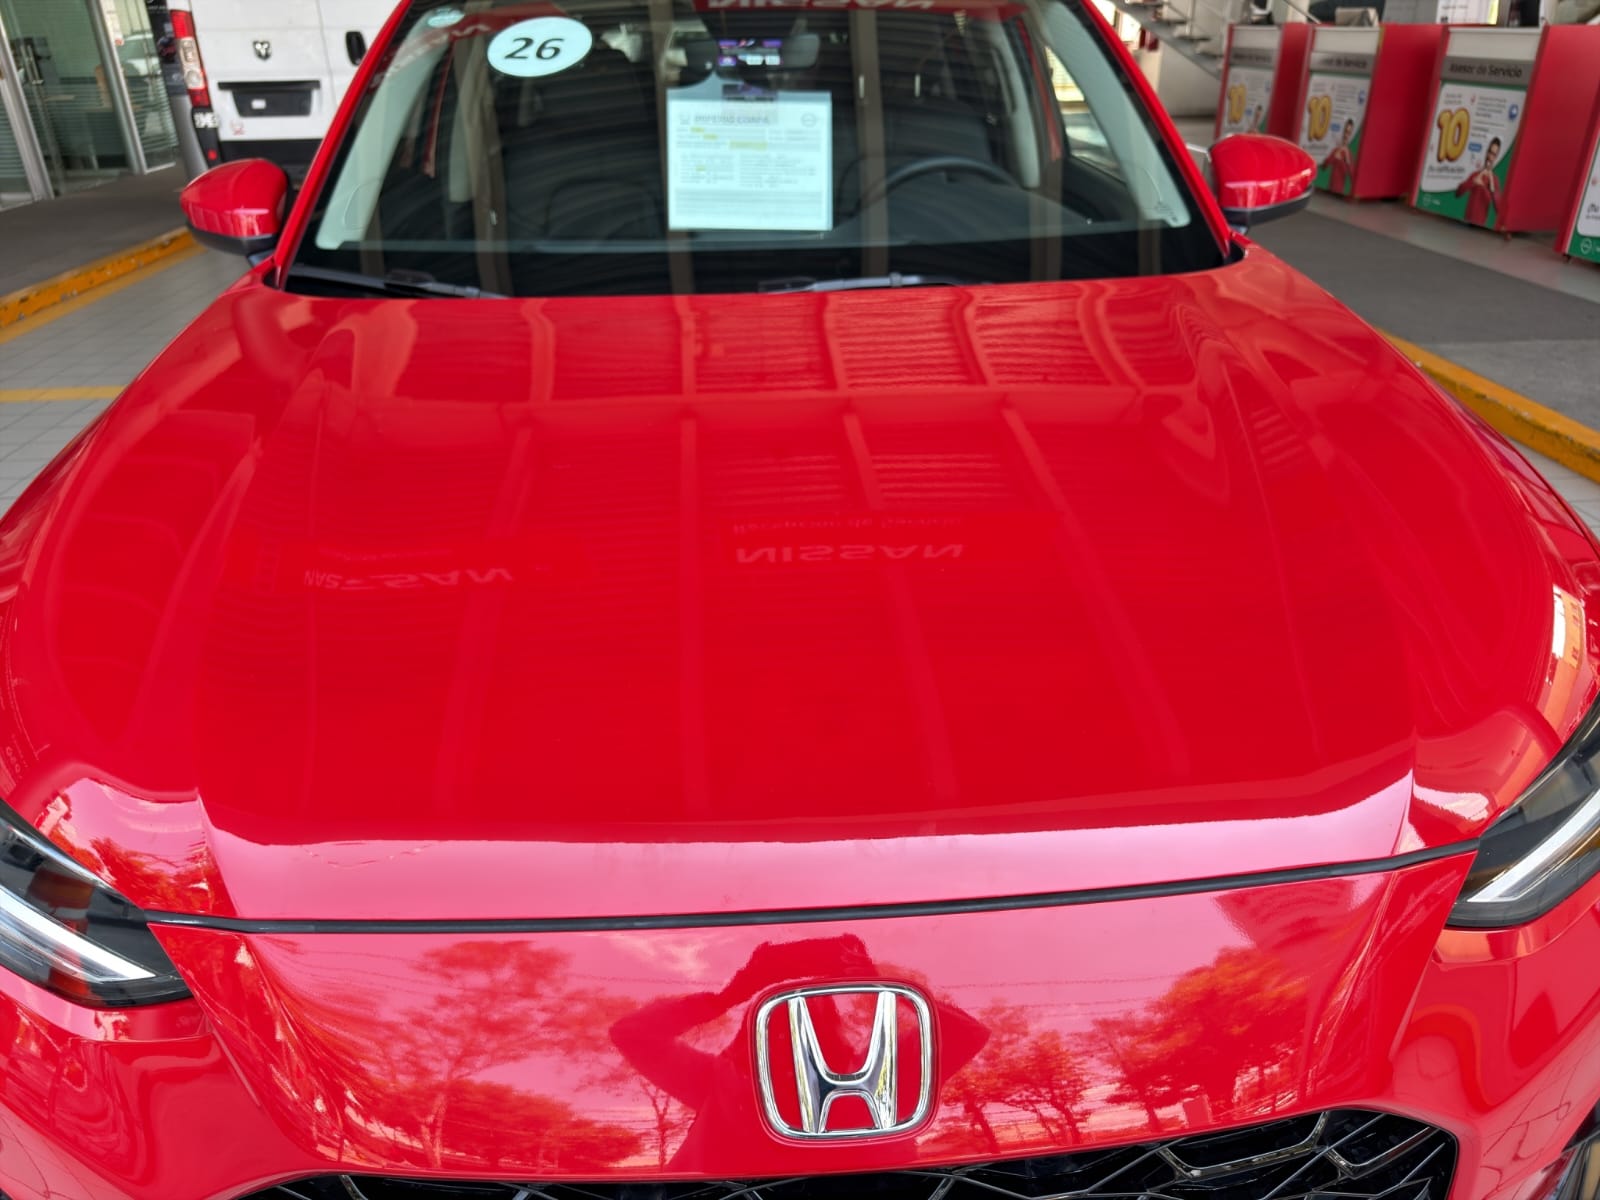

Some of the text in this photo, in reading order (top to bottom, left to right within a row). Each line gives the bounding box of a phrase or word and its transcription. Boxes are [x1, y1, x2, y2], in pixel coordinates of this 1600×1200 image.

[504, 38, 564, 60] 26
[1487, 64, 1523, 78] Servicio
[1307, 95, 1332, 142] 10
[1437, 107, 1471, 163] 10
